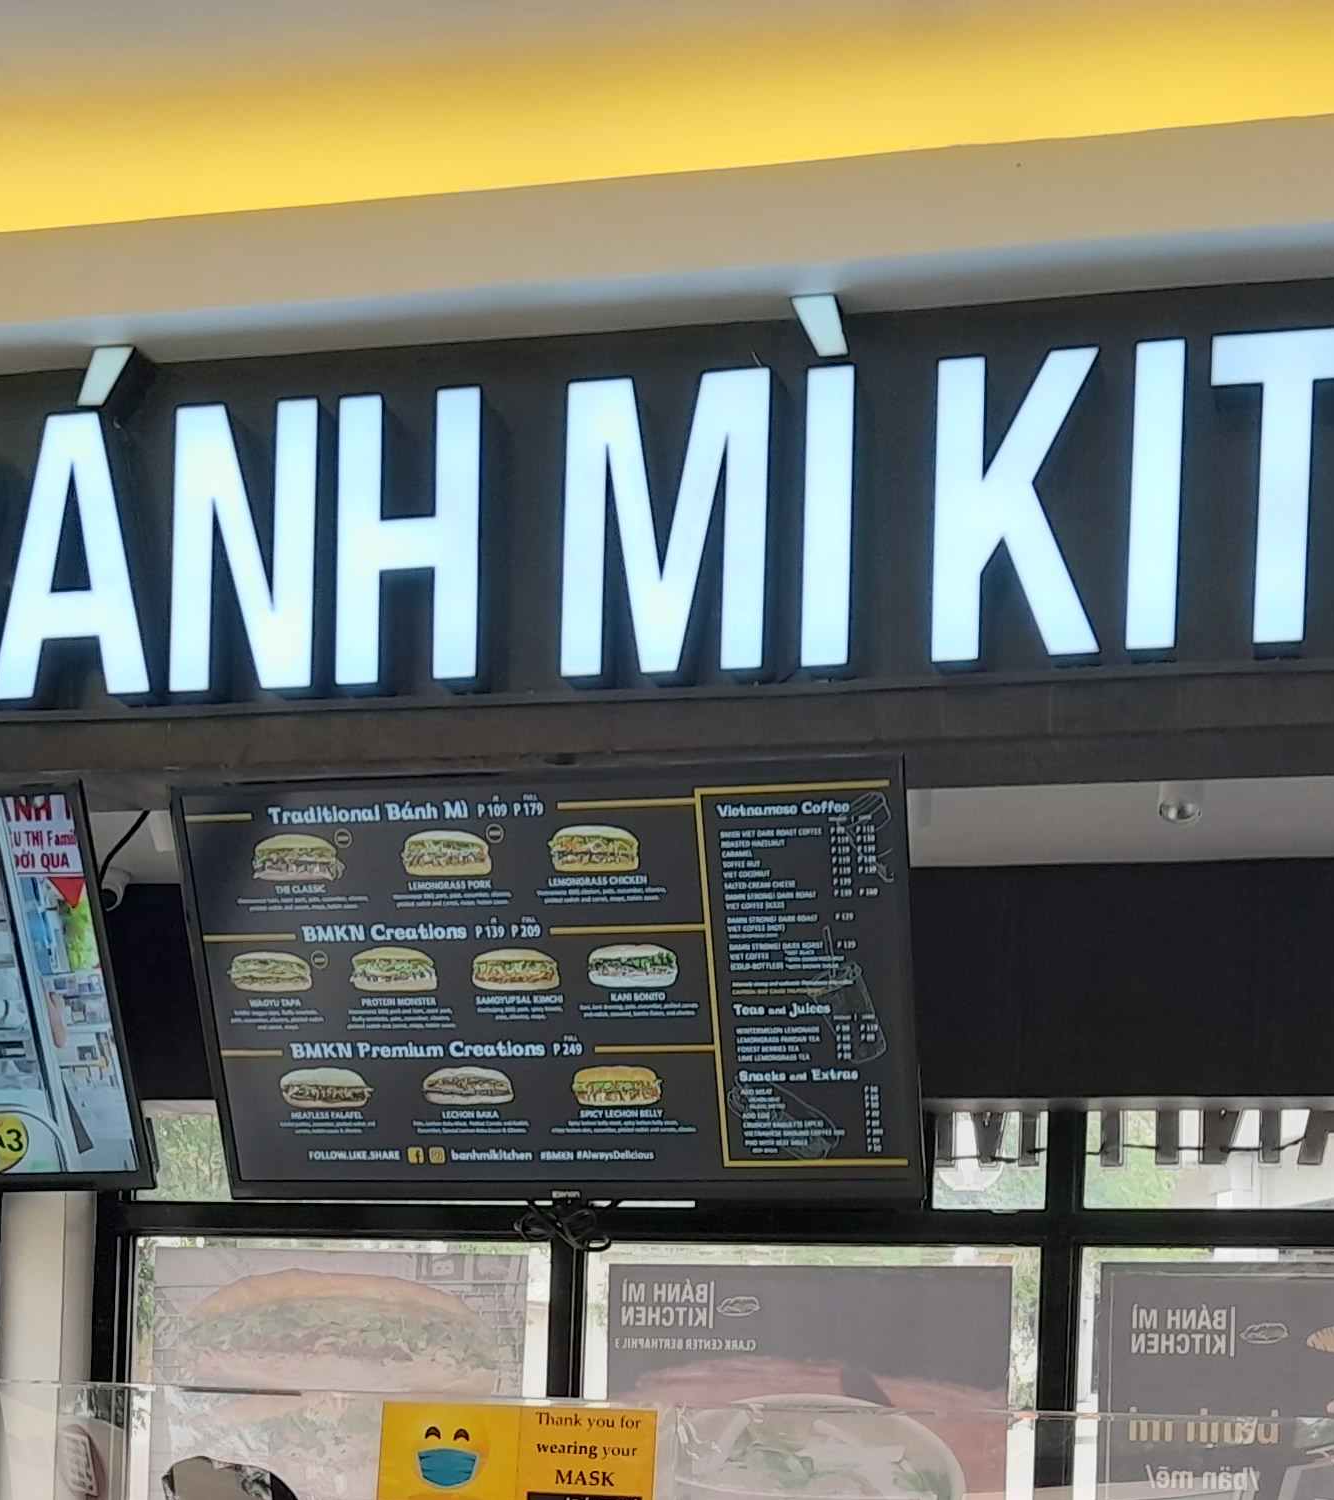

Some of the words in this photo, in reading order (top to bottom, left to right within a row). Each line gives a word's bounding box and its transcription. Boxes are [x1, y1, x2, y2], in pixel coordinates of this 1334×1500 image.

[560, 294, 855, 678] MÌ
[268, 804, 382, 825] Traditional
[385, 800, 438, 822] Bánh
[41, 852, 70, 872] QUA
[468, 880, 491, 889] PORK
[609, 875, 648, 885] CHICKEN
[301, 924, 366, 943] BMKN
[370, 922, 467, 941] Creations
[290, 1042, 353, 1059] BMKN
[356, 1041, 444, 1059] Premium
[449, 1040, 546, 1058] Creations
[811, 1069, 858, 1082] Extras
[580, 1110, 603, 1119] SPICY
[535, 1411, 583, 1429] Thank
[587, 1415, 615, 1431] you
[620, 1413, 642, 1430] for
[536, 1440, 599, 1460] wearing
[602, 1445, 637, 1460] your
[555, 1469, 615, 1487] MASK
